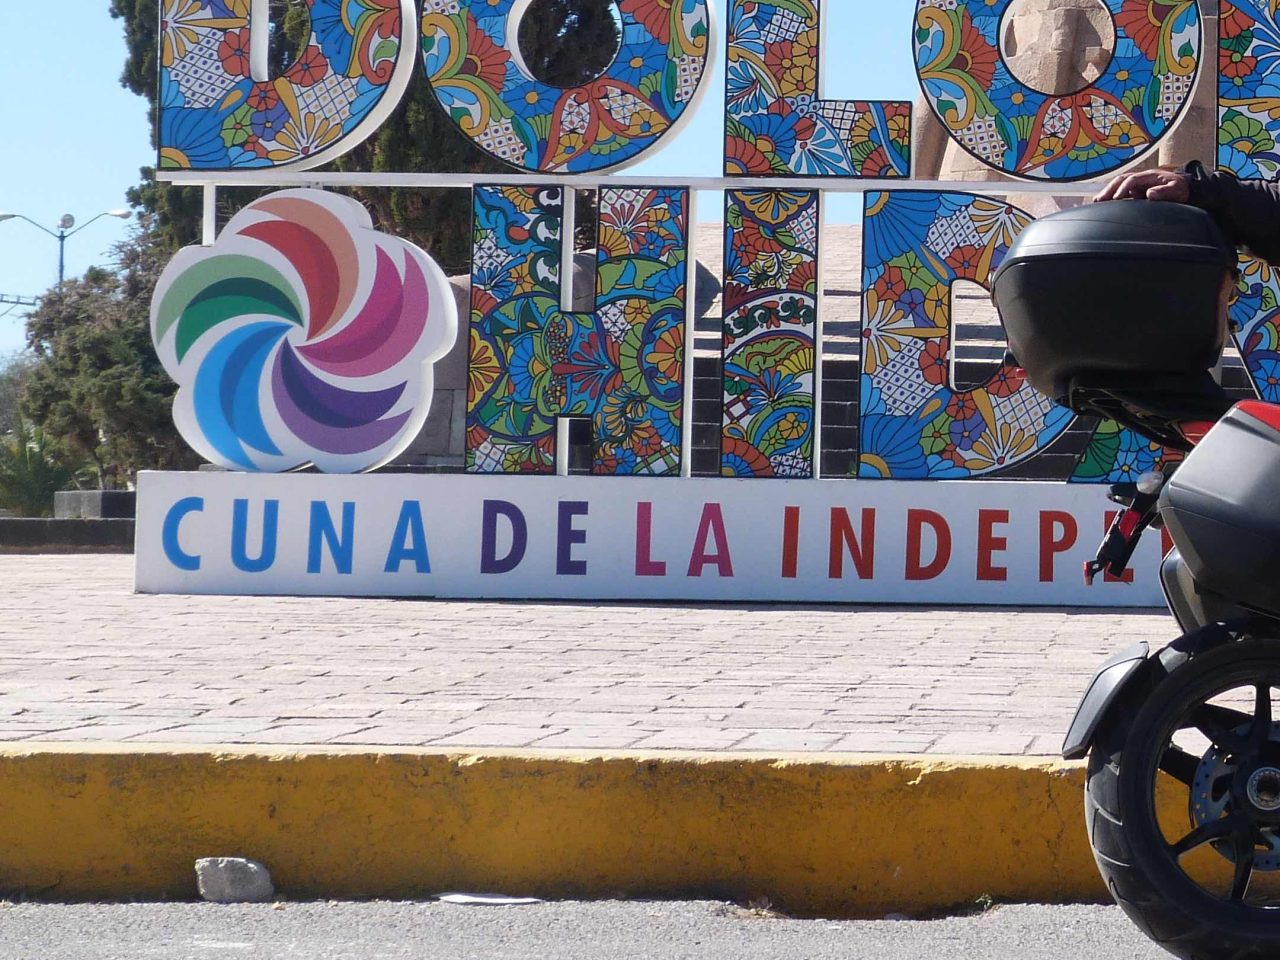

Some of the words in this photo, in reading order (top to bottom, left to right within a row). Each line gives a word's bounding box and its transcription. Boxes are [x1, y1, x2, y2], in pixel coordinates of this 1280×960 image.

[161, 495, 432, 575] CUNA
[479, 499, 590, 577] DE
[635, 501, 735, 579] LA
